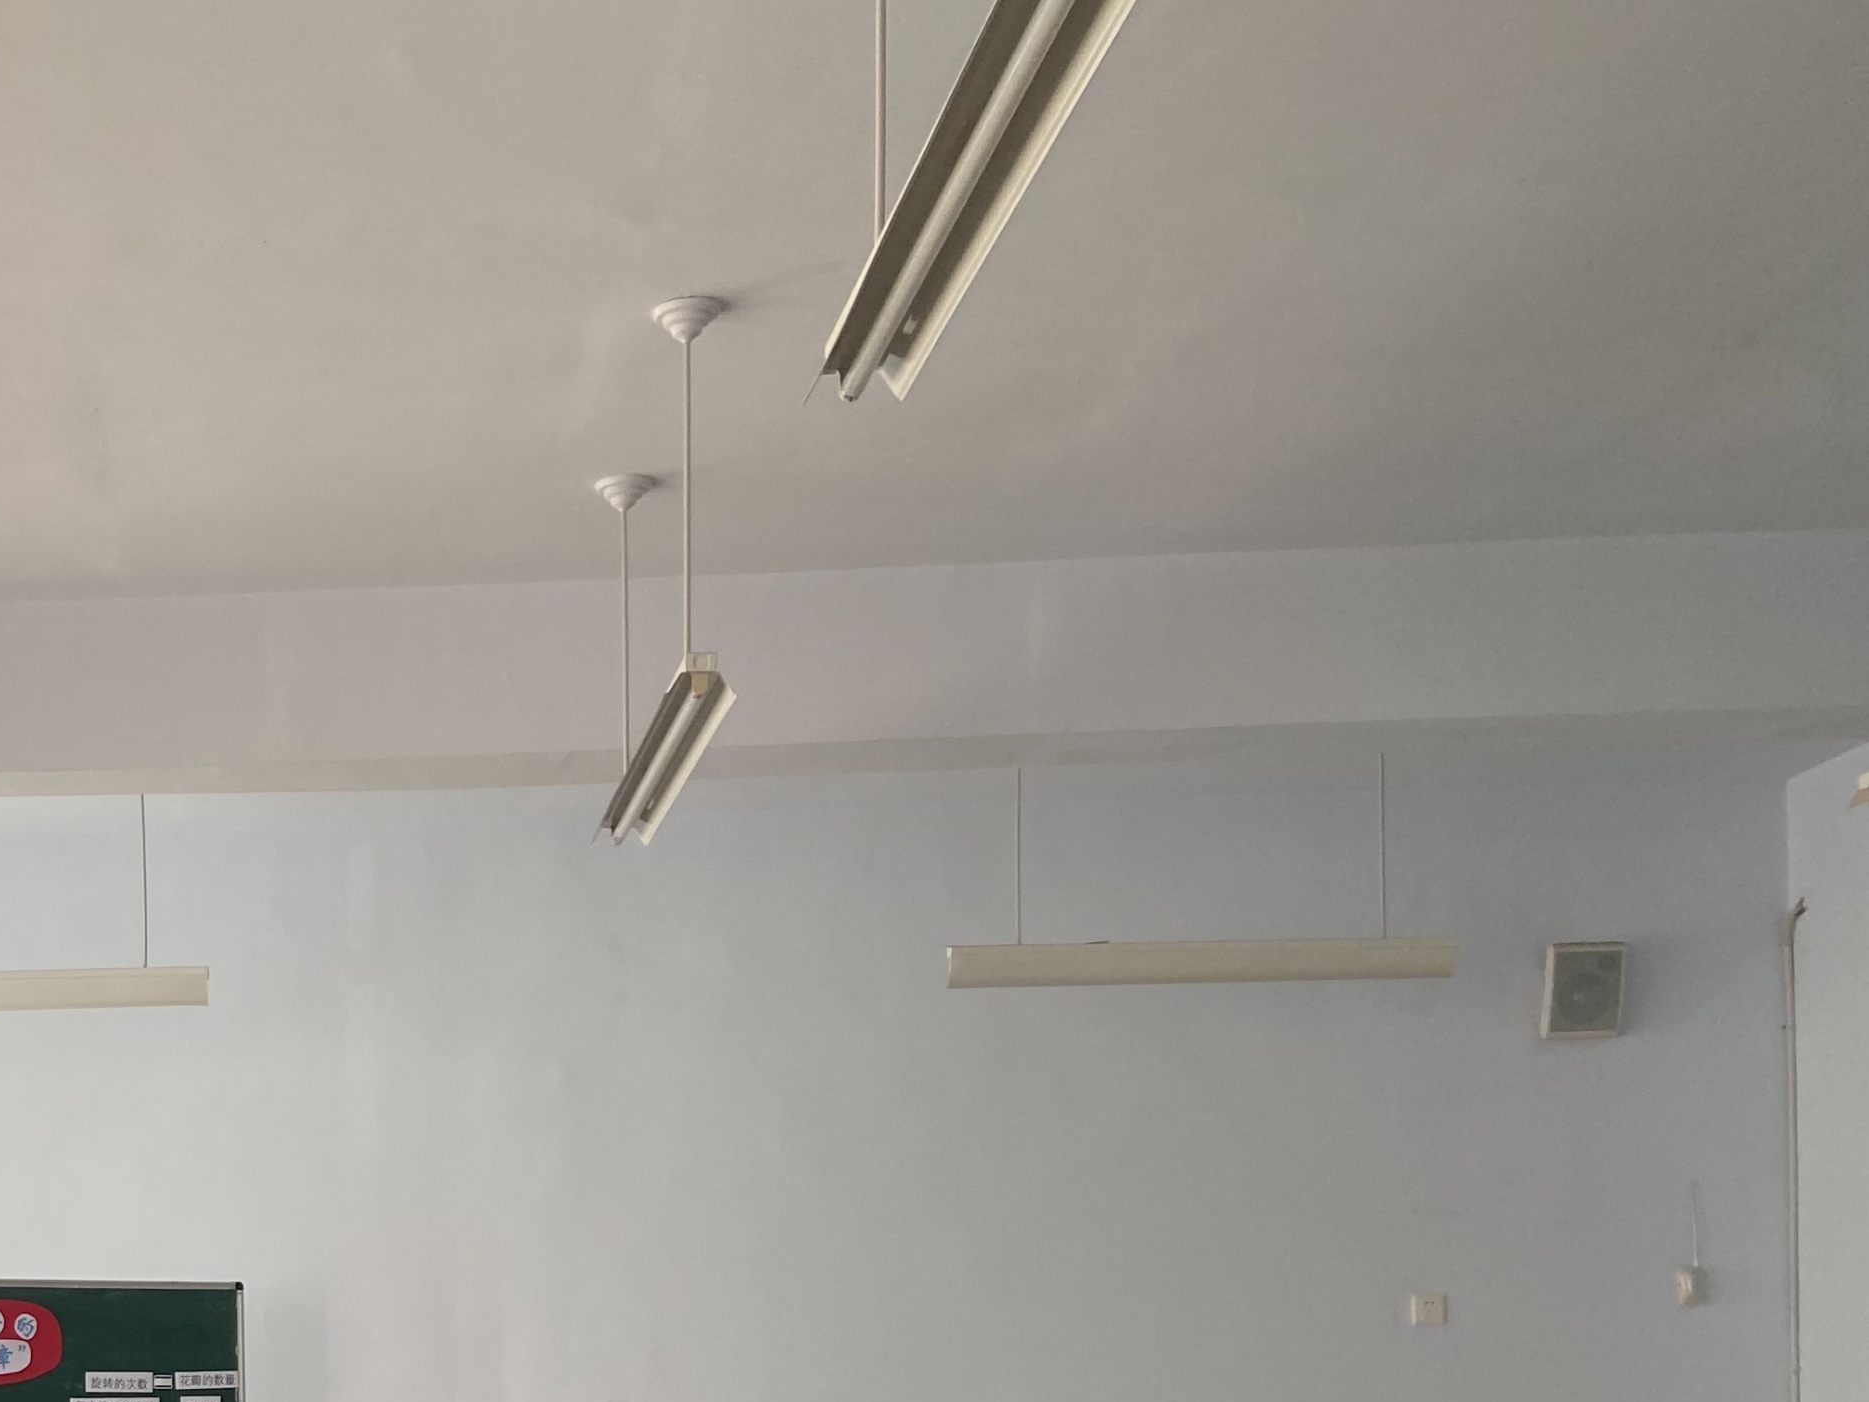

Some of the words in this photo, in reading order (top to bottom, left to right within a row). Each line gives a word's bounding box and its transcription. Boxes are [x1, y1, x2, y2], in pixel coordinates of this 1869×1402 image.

[90, 1376, 150, 1391] 旋转的次数
[179, 1373, 236, 1387] 花瓣的数量
